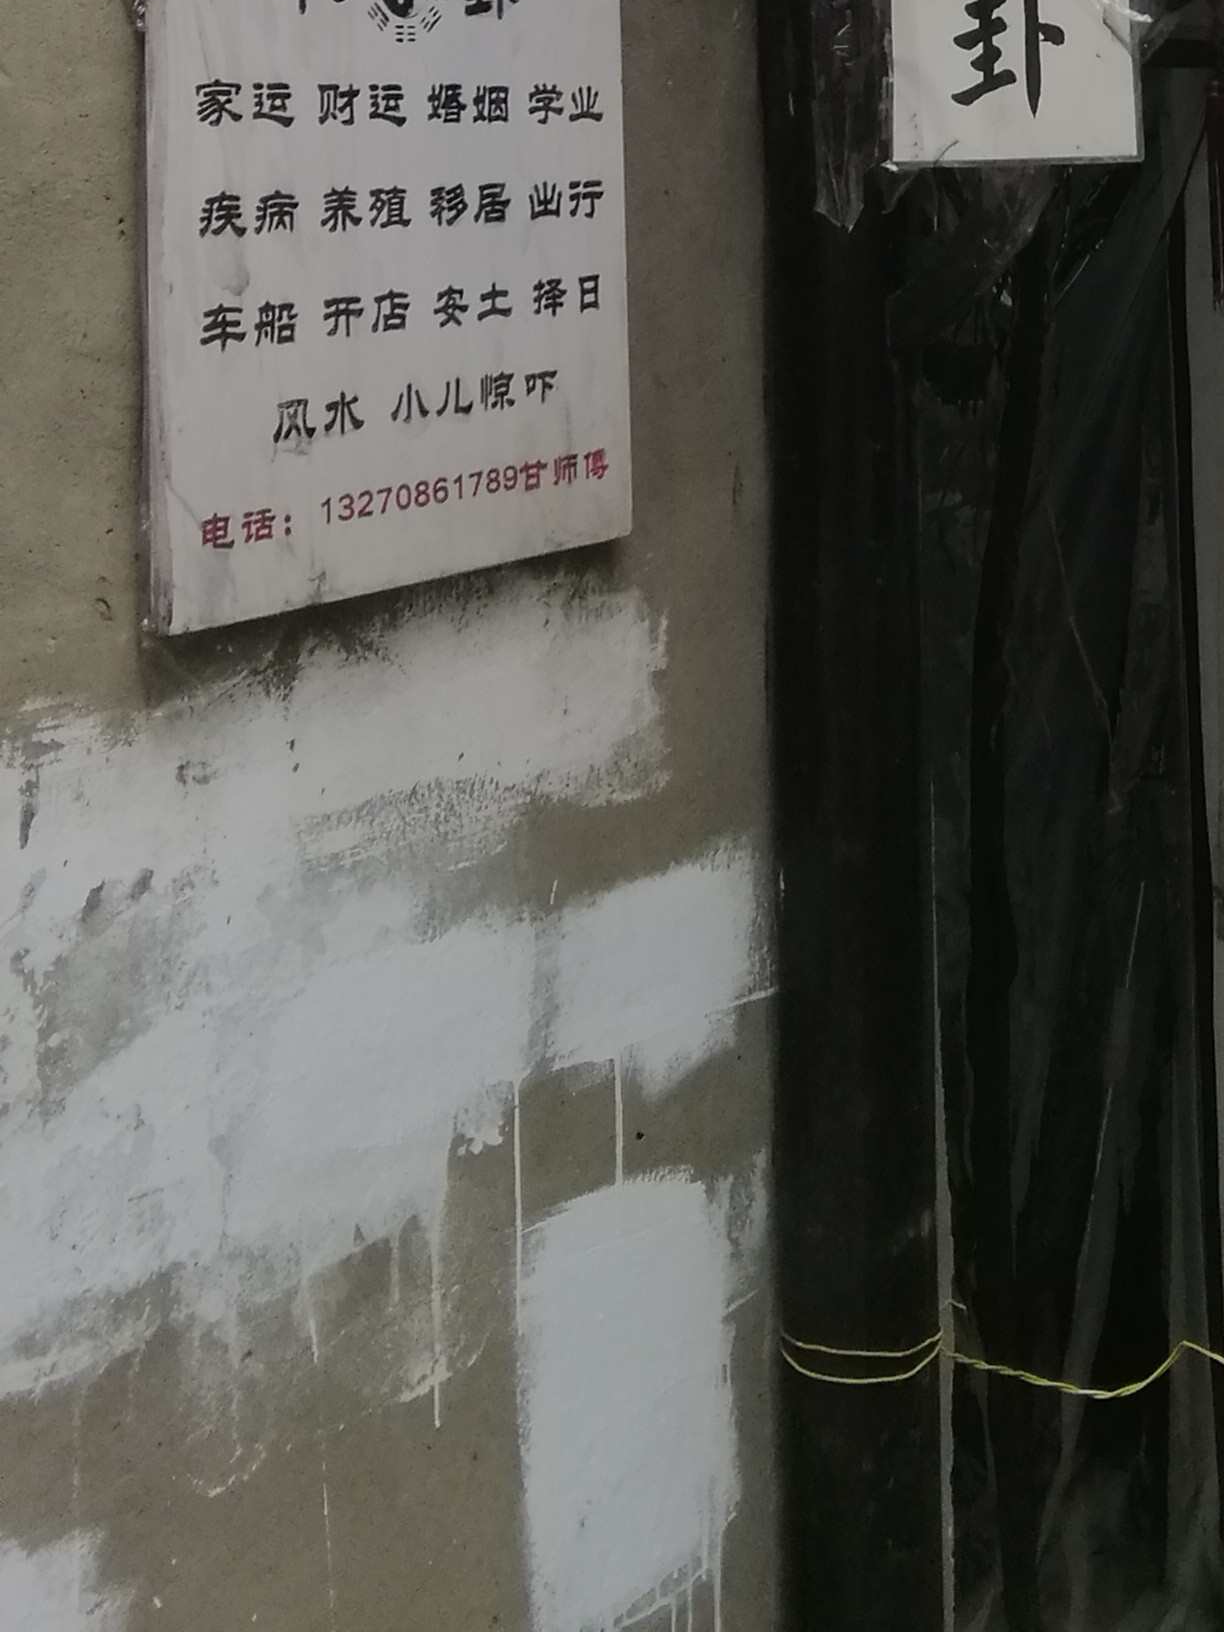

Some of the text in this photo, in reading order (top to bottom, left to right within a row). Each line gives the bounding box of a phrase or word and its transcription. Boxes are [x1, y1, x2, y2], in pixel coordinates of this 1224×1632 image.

[195, 79, 603, 127] 家运 财运 婚姻 学业
[199, 180, 604, 237] 疾病 养殖 移居 出行
[199, 274, 600, 352] 车船 开店 安土 择日
[273, 369, 558, 443] 风水 小儿惊吓
